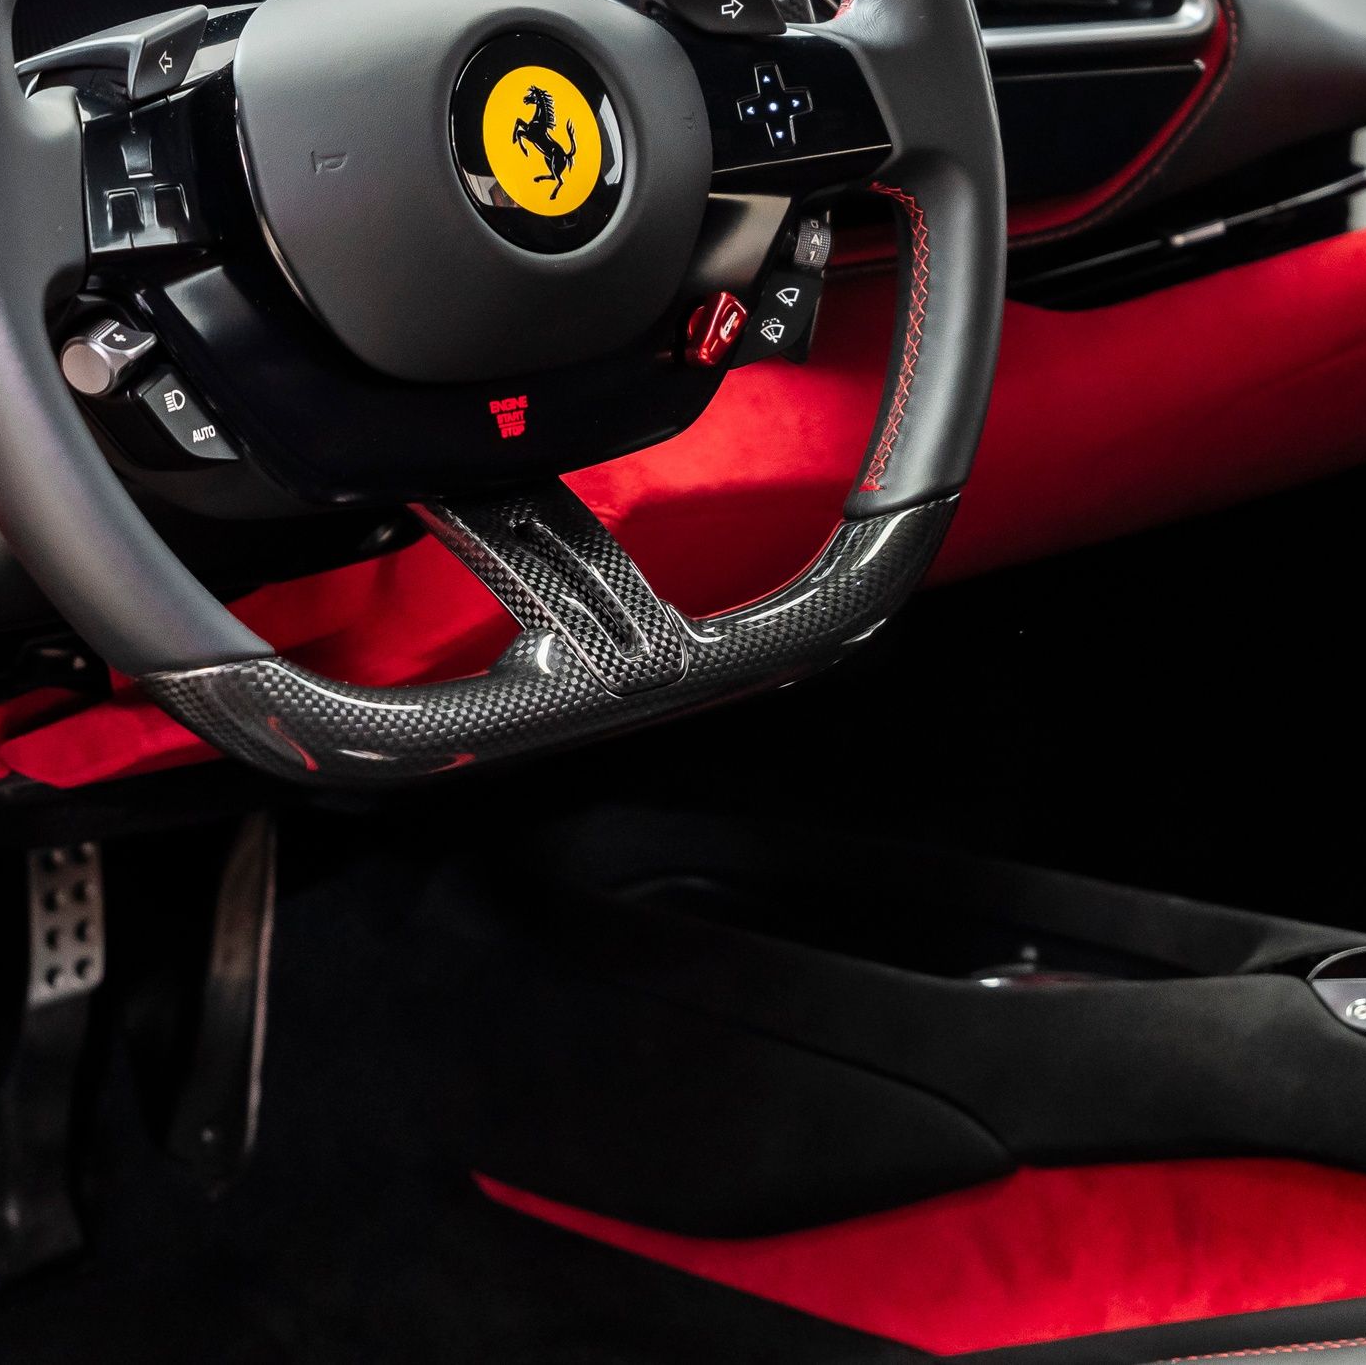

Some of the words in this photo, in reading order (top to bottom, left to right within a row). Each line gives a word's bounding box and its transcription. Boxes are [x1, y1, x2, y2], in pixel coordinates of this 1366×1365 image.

[489, 394, 529, 414] ENGINE
[496, 409, 525, 425] START
[192, 424, 216, 443] AUTO
